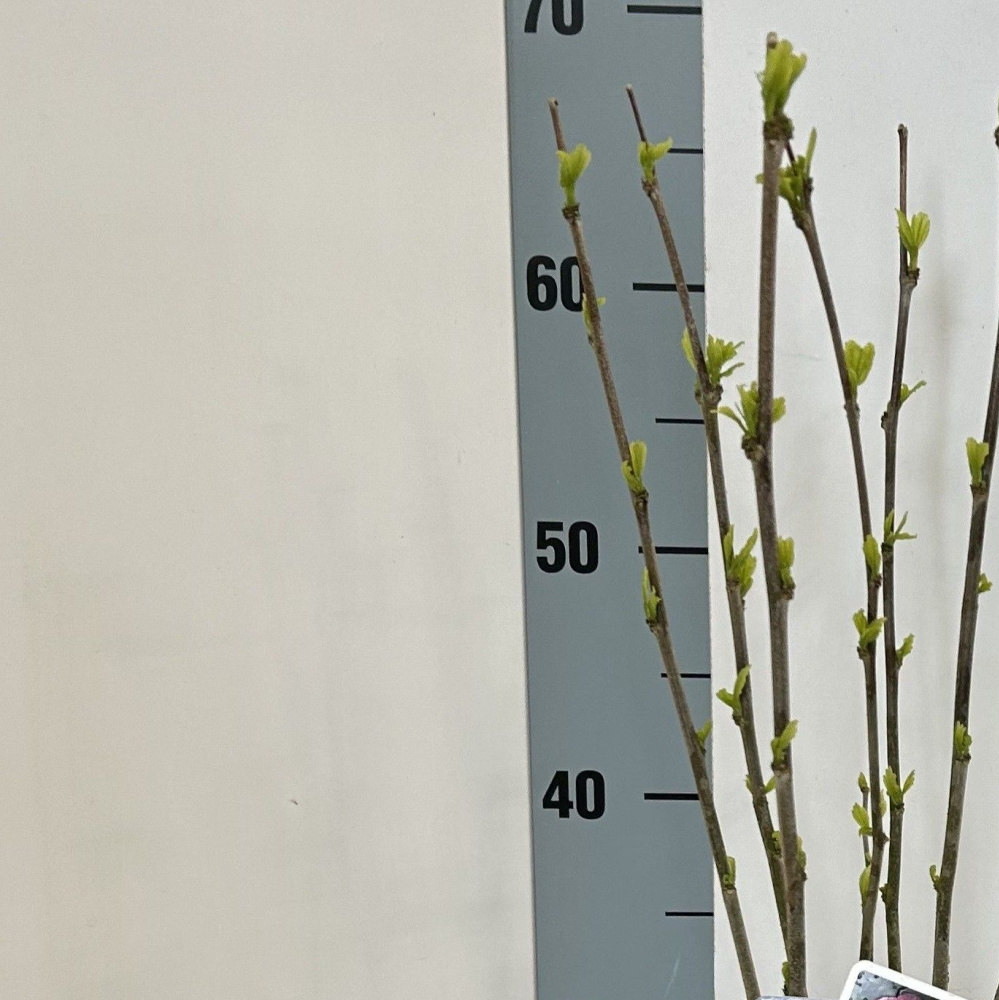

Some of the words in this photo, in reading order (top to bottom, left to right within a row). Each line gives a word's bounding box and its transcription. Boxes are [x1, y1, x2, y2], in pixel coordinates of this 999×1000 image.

[524, 0, 584, 35] 70
[526, 255, 584, 312] 60
[536, 521, 599, 574] 50
[542, 770, 606, 820] 40
